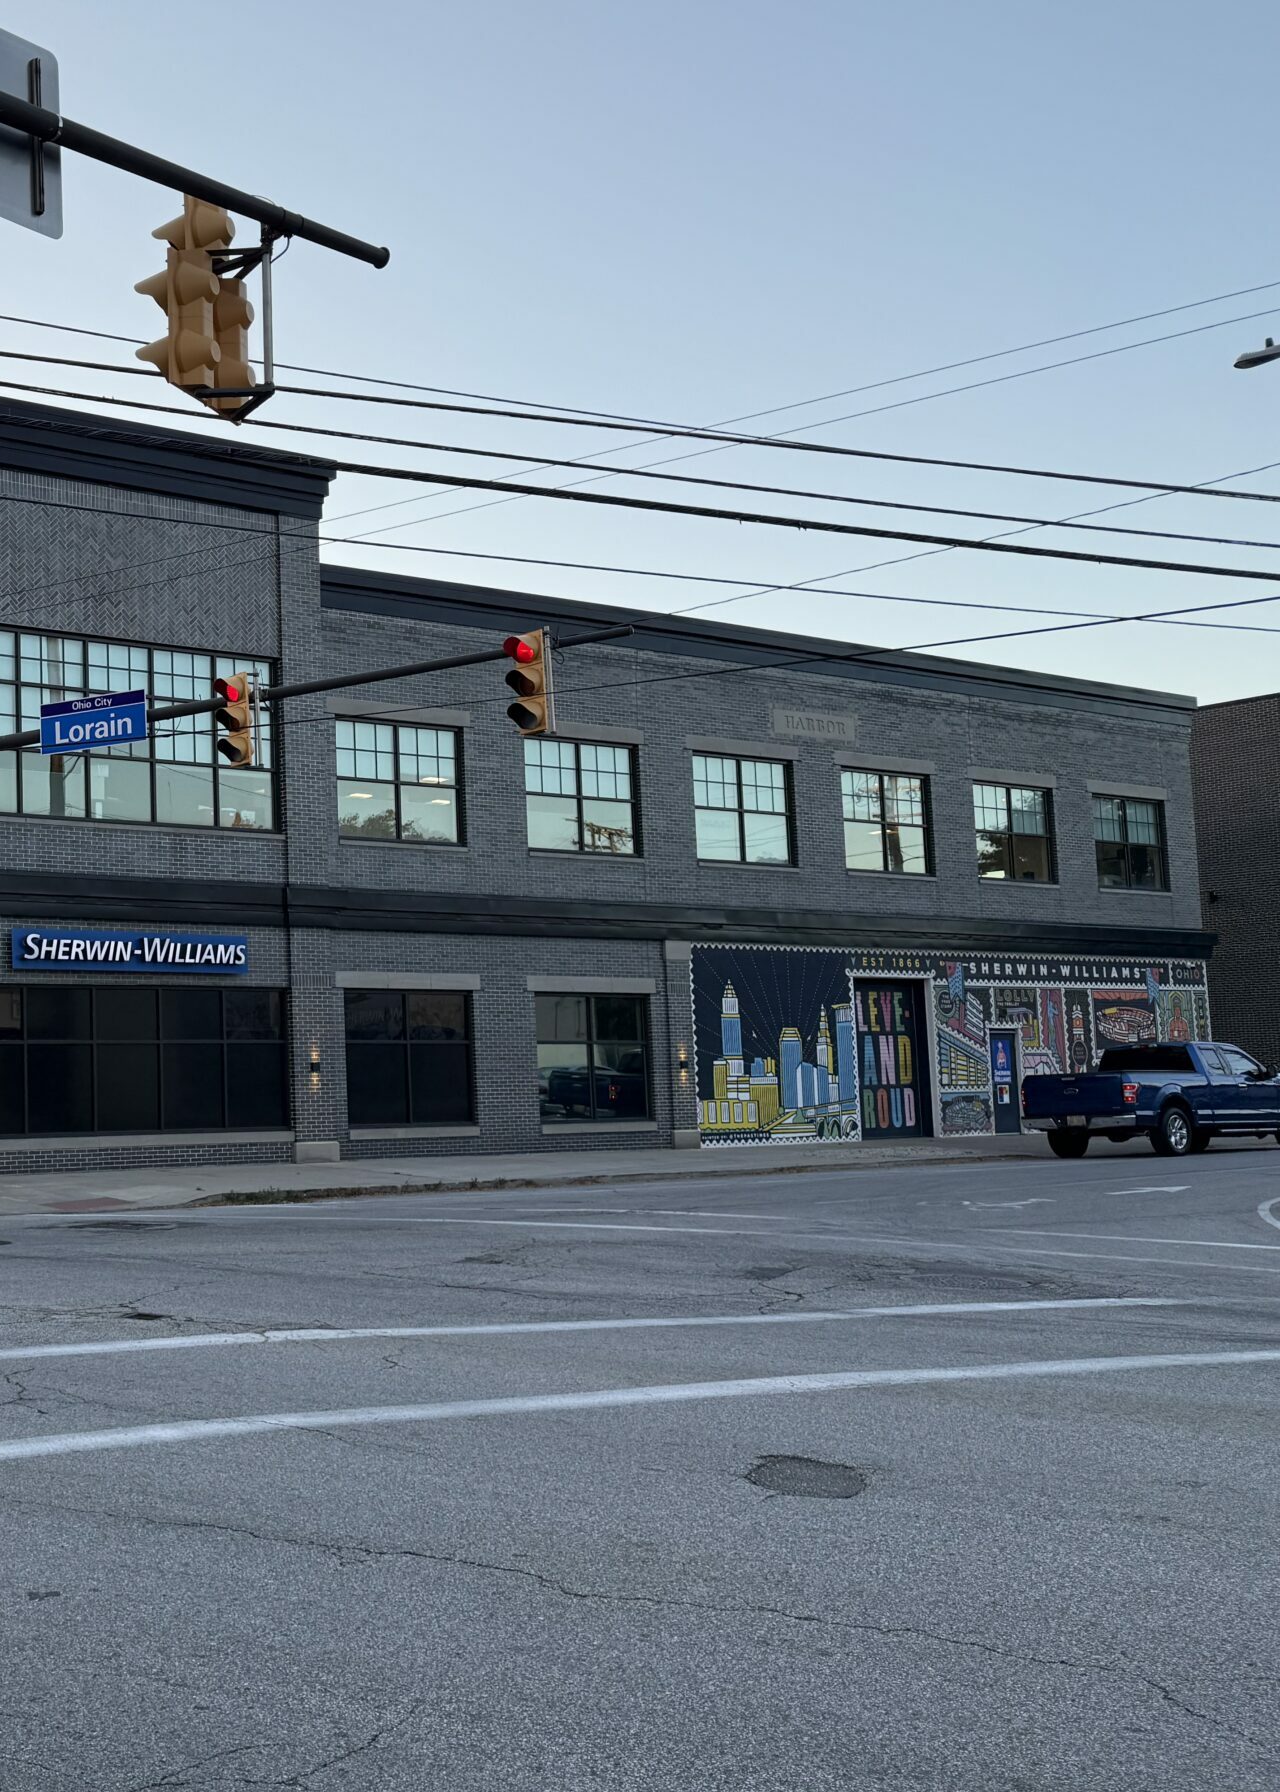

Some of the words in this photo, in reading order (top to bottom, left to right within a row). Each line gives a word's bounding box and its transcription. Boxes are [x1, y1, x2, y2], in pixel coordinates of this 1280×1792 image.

[72, 699, 92, 710] Ohio
[95, 696, 113, 708] City
[54, 713, 133, 746] Lorain
[784, 714, 846, 735] HARBOR
[24, 933, 246, 965] SHERWIN-WILLIAMS
[862, 957, 884, 967] EST
[892, 958, 920, 968] 1866
[969, 962, 1141, 979] SHERWIN-WILLIAMS
[1175, 968, 1200, 980] OHIO
[996, 989, 1035, 1003] LOLLY
